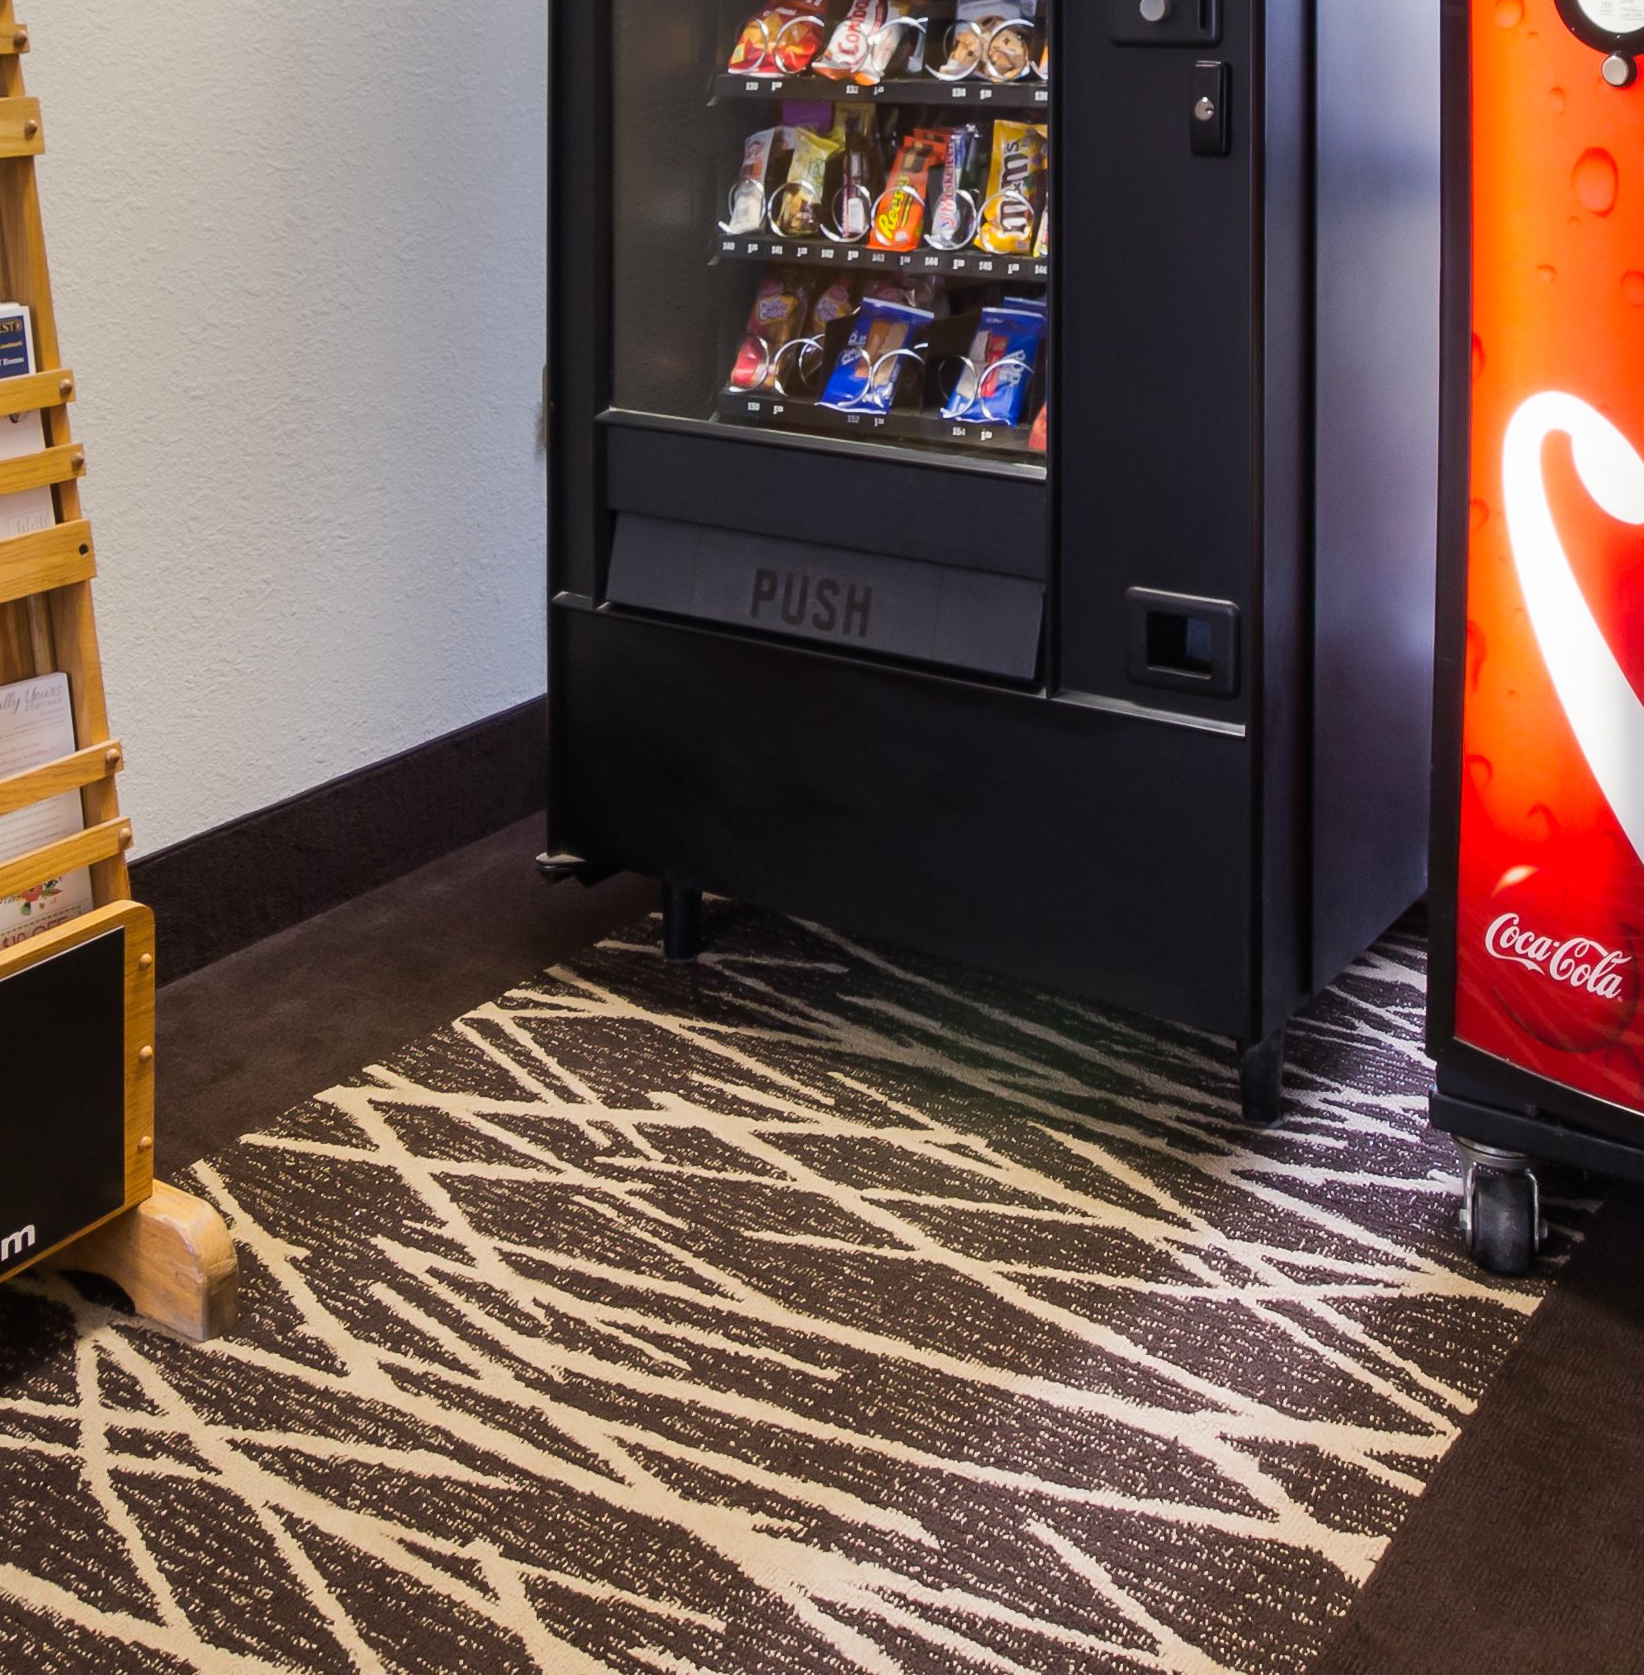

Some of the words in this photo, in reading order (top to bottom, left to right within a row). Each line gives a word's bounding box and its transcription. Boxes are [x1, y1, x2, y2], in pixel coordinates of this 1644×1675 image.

[751, 567, 873, 639] PUSH
[25, 684, 63, 705] Yours
[1485, 912, 1633, 999] Coca-Cola
